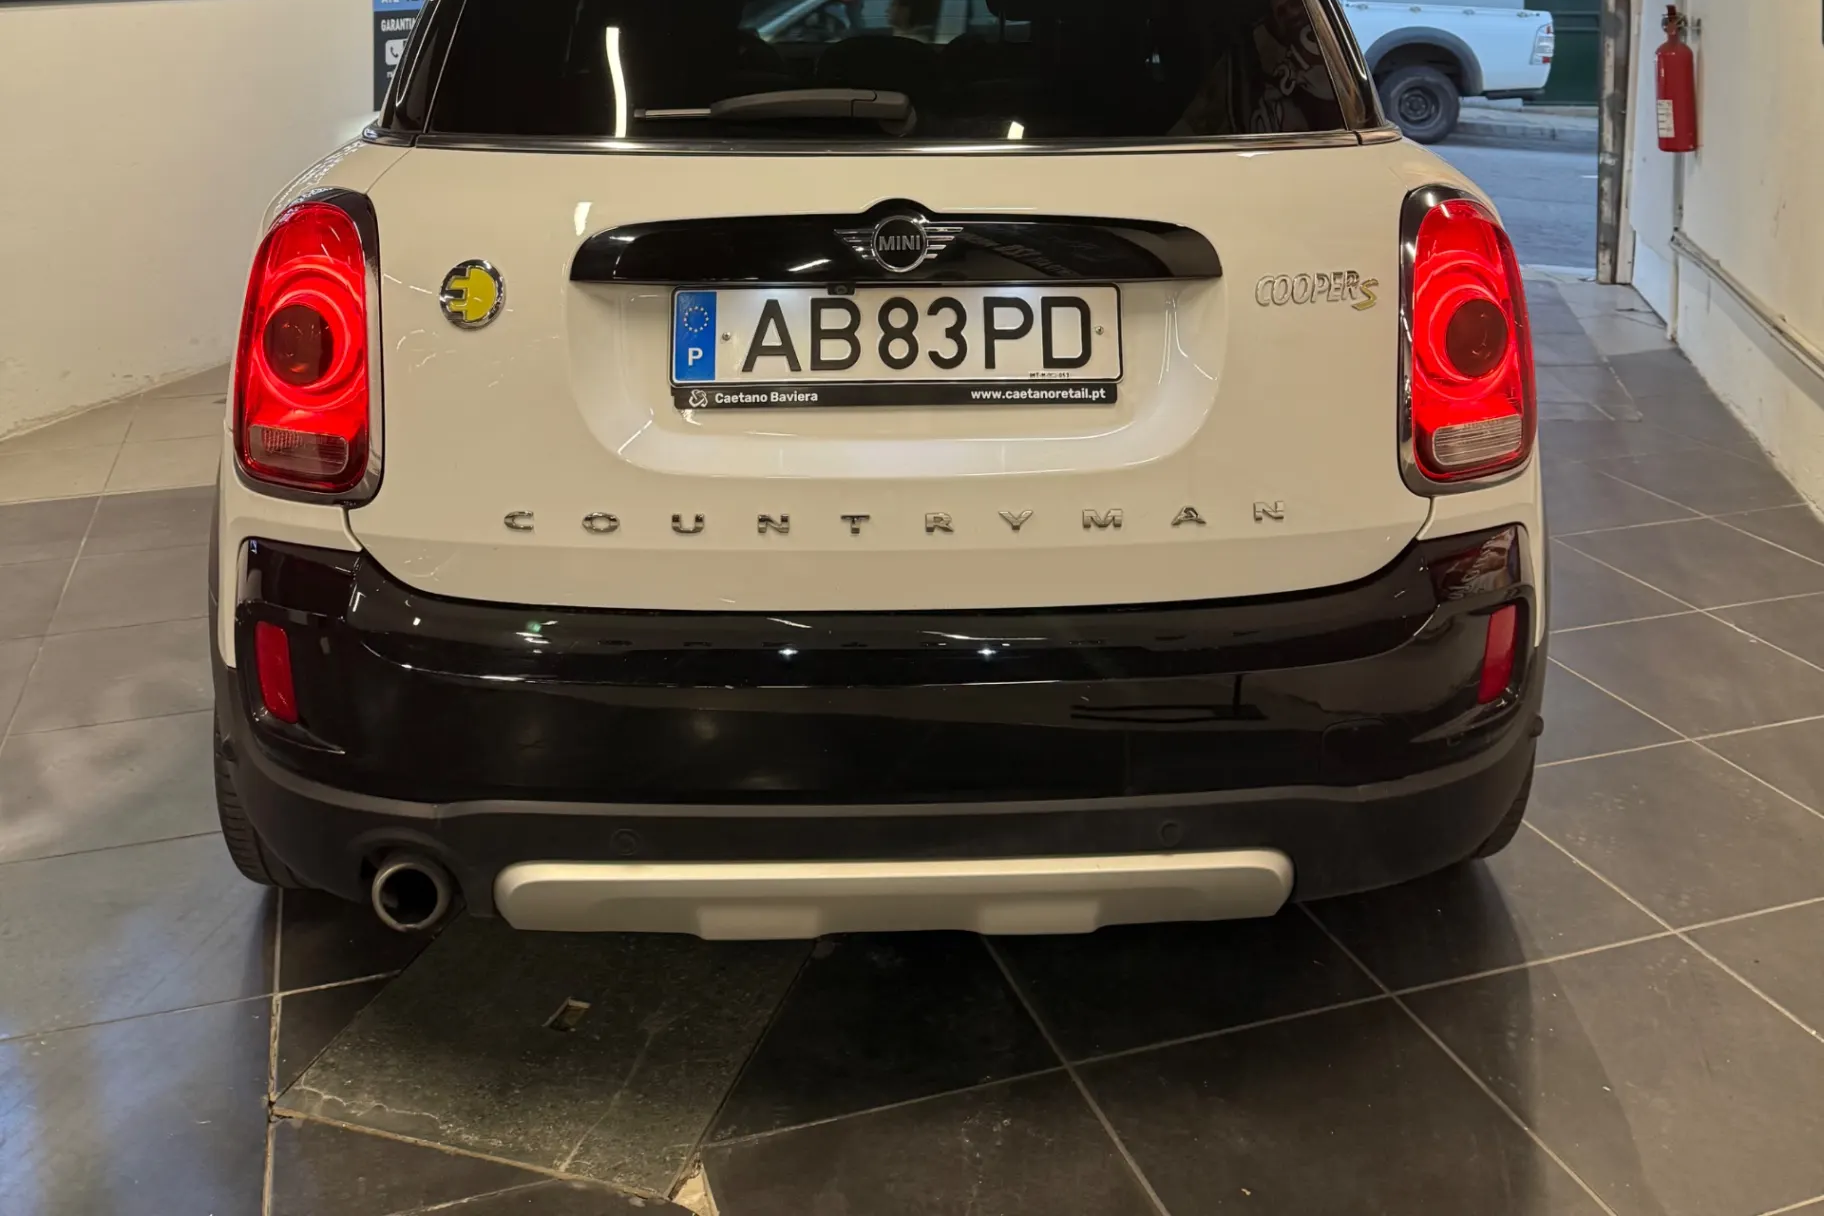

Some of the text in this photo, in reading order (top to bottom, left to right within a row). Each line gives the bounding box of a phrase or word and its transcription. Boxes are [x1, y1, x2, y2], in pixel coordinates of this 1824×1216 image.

[879, 235, 921, 251] MINI
[687, 347, 703, 366] P
[715, 390, 819, 404] Caetano Baviera
[970, 387, 1107, 401] www.caetanoretail.pt
[504, 499, 1286, 535] COUNTRYMAN
